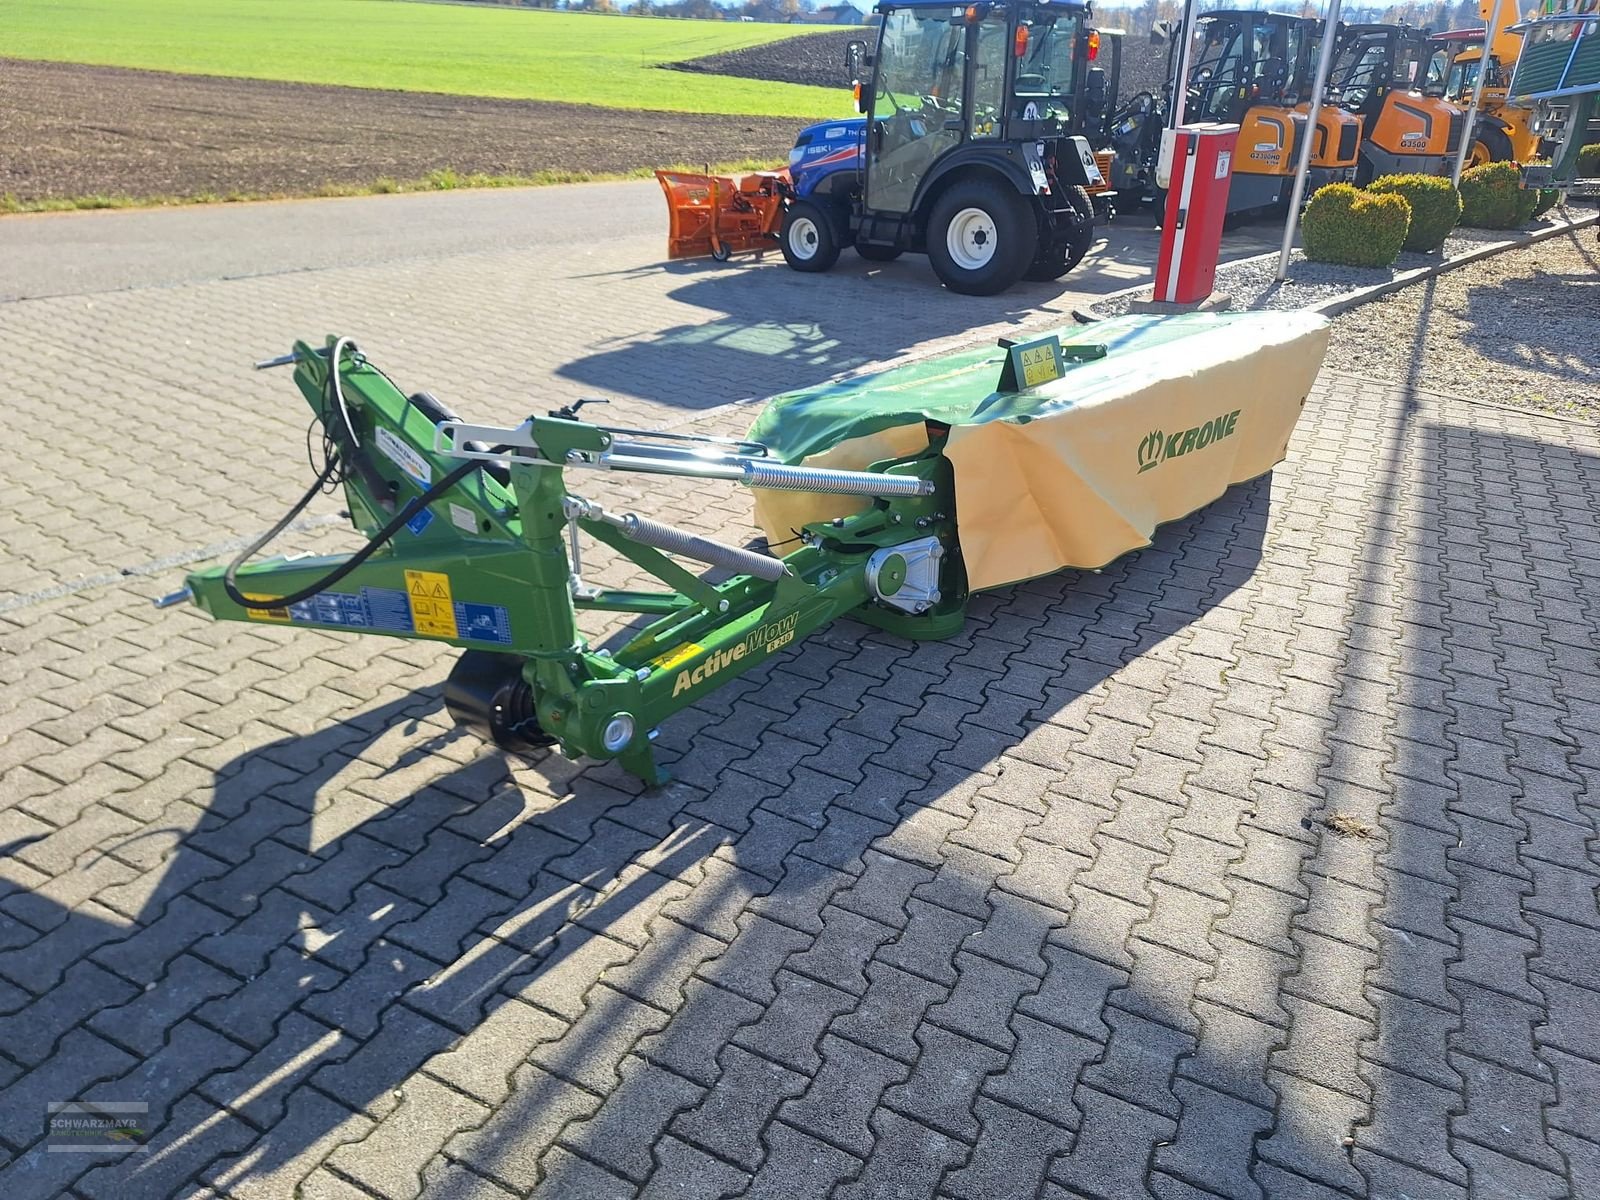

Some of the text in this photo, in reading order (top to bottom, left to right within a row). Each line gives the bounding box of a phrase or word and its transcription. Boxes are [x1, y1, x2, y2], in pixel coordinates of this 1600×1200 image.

[808, 145, 831, 154] ISEKI
[1160, 409, 1242, 463] KRONE
[671, 611, 799, 698] ActiveMow
